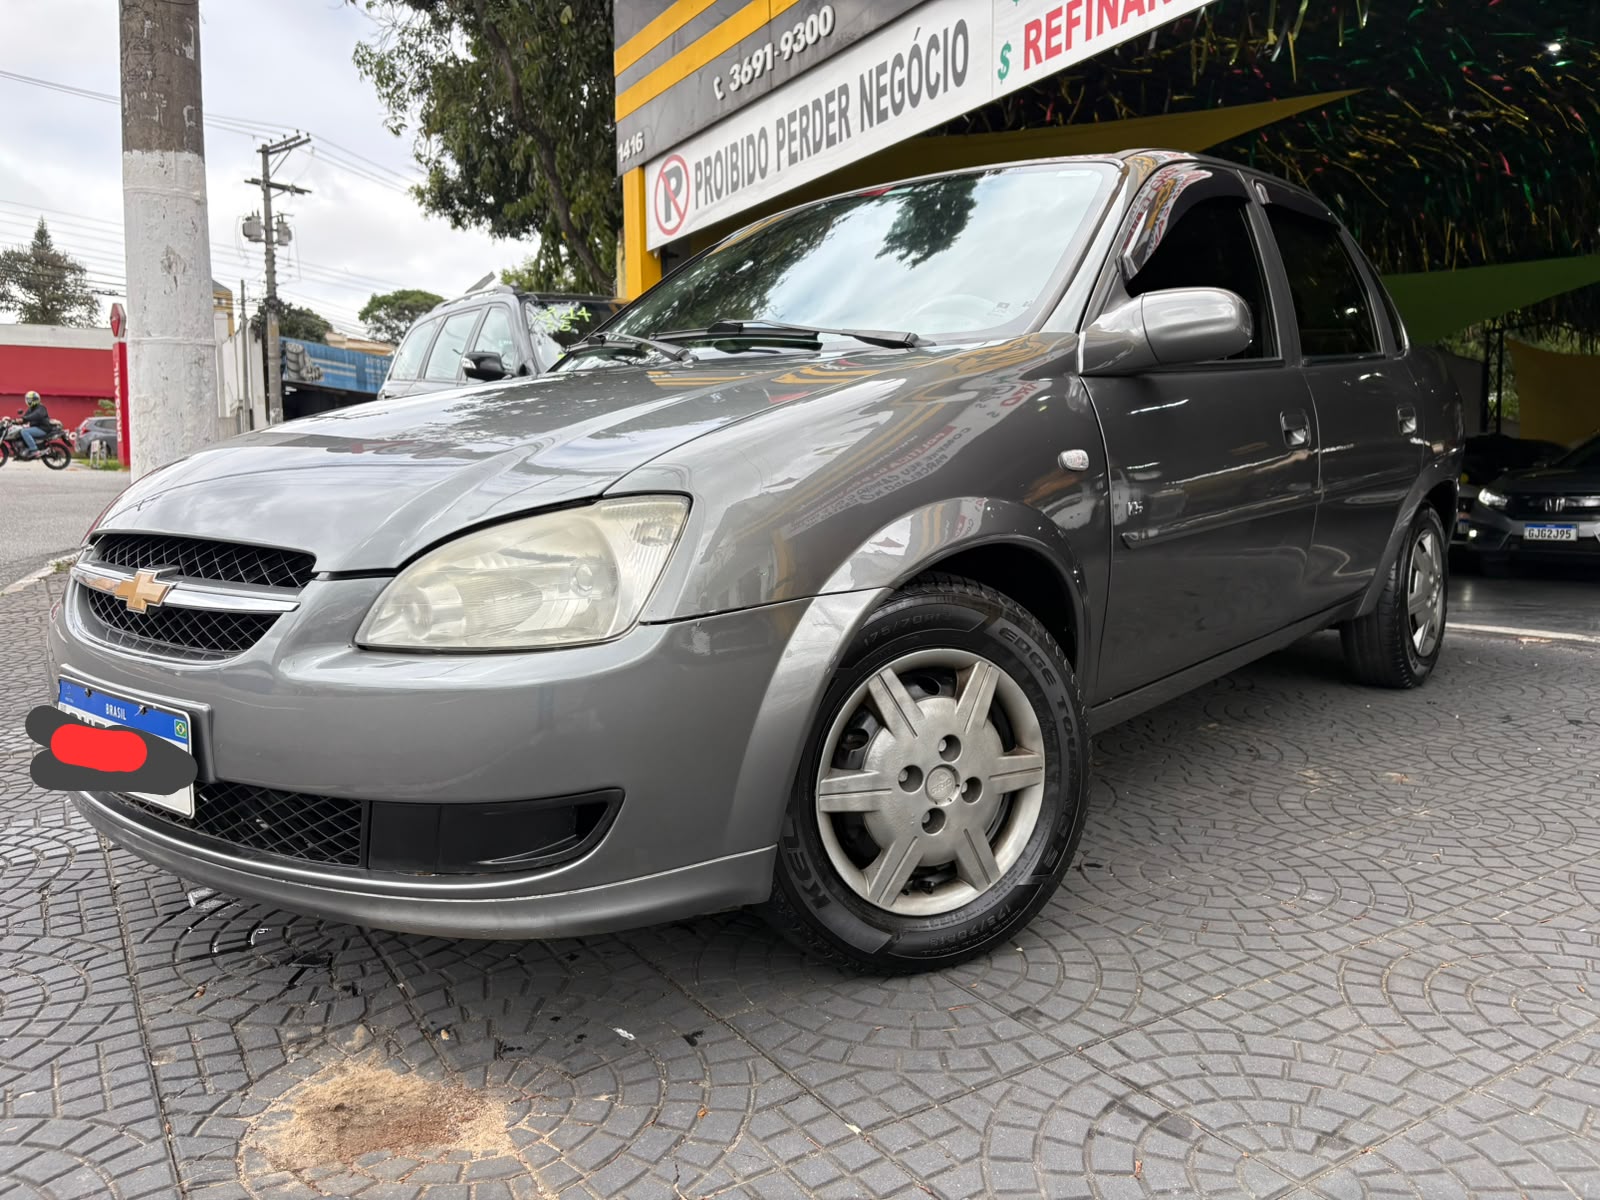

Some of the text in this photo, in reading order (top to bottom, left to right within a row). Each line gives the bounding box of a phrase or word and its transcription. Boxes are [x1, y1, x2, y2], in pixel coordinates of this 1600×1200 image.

[729, 5, 834, 91] 3691-9300
[1023, 0, 1171, 70] REFINA
[617, 132, 643, 162] 1416
[694, 126, 769, 209] PROIBIDO
[776, 83, 851, 172] PERDER
[860, 19, 969, 132] NEGÓCIO
[114, 361, 123, 442] DROGASIL
[1528, 528, 1571, 539] GJG2J95
[999, 627, 1058, 686] EDGE
[105, 703, 127, 720] BRASIL
[782, 812, 832, 909] KEL
